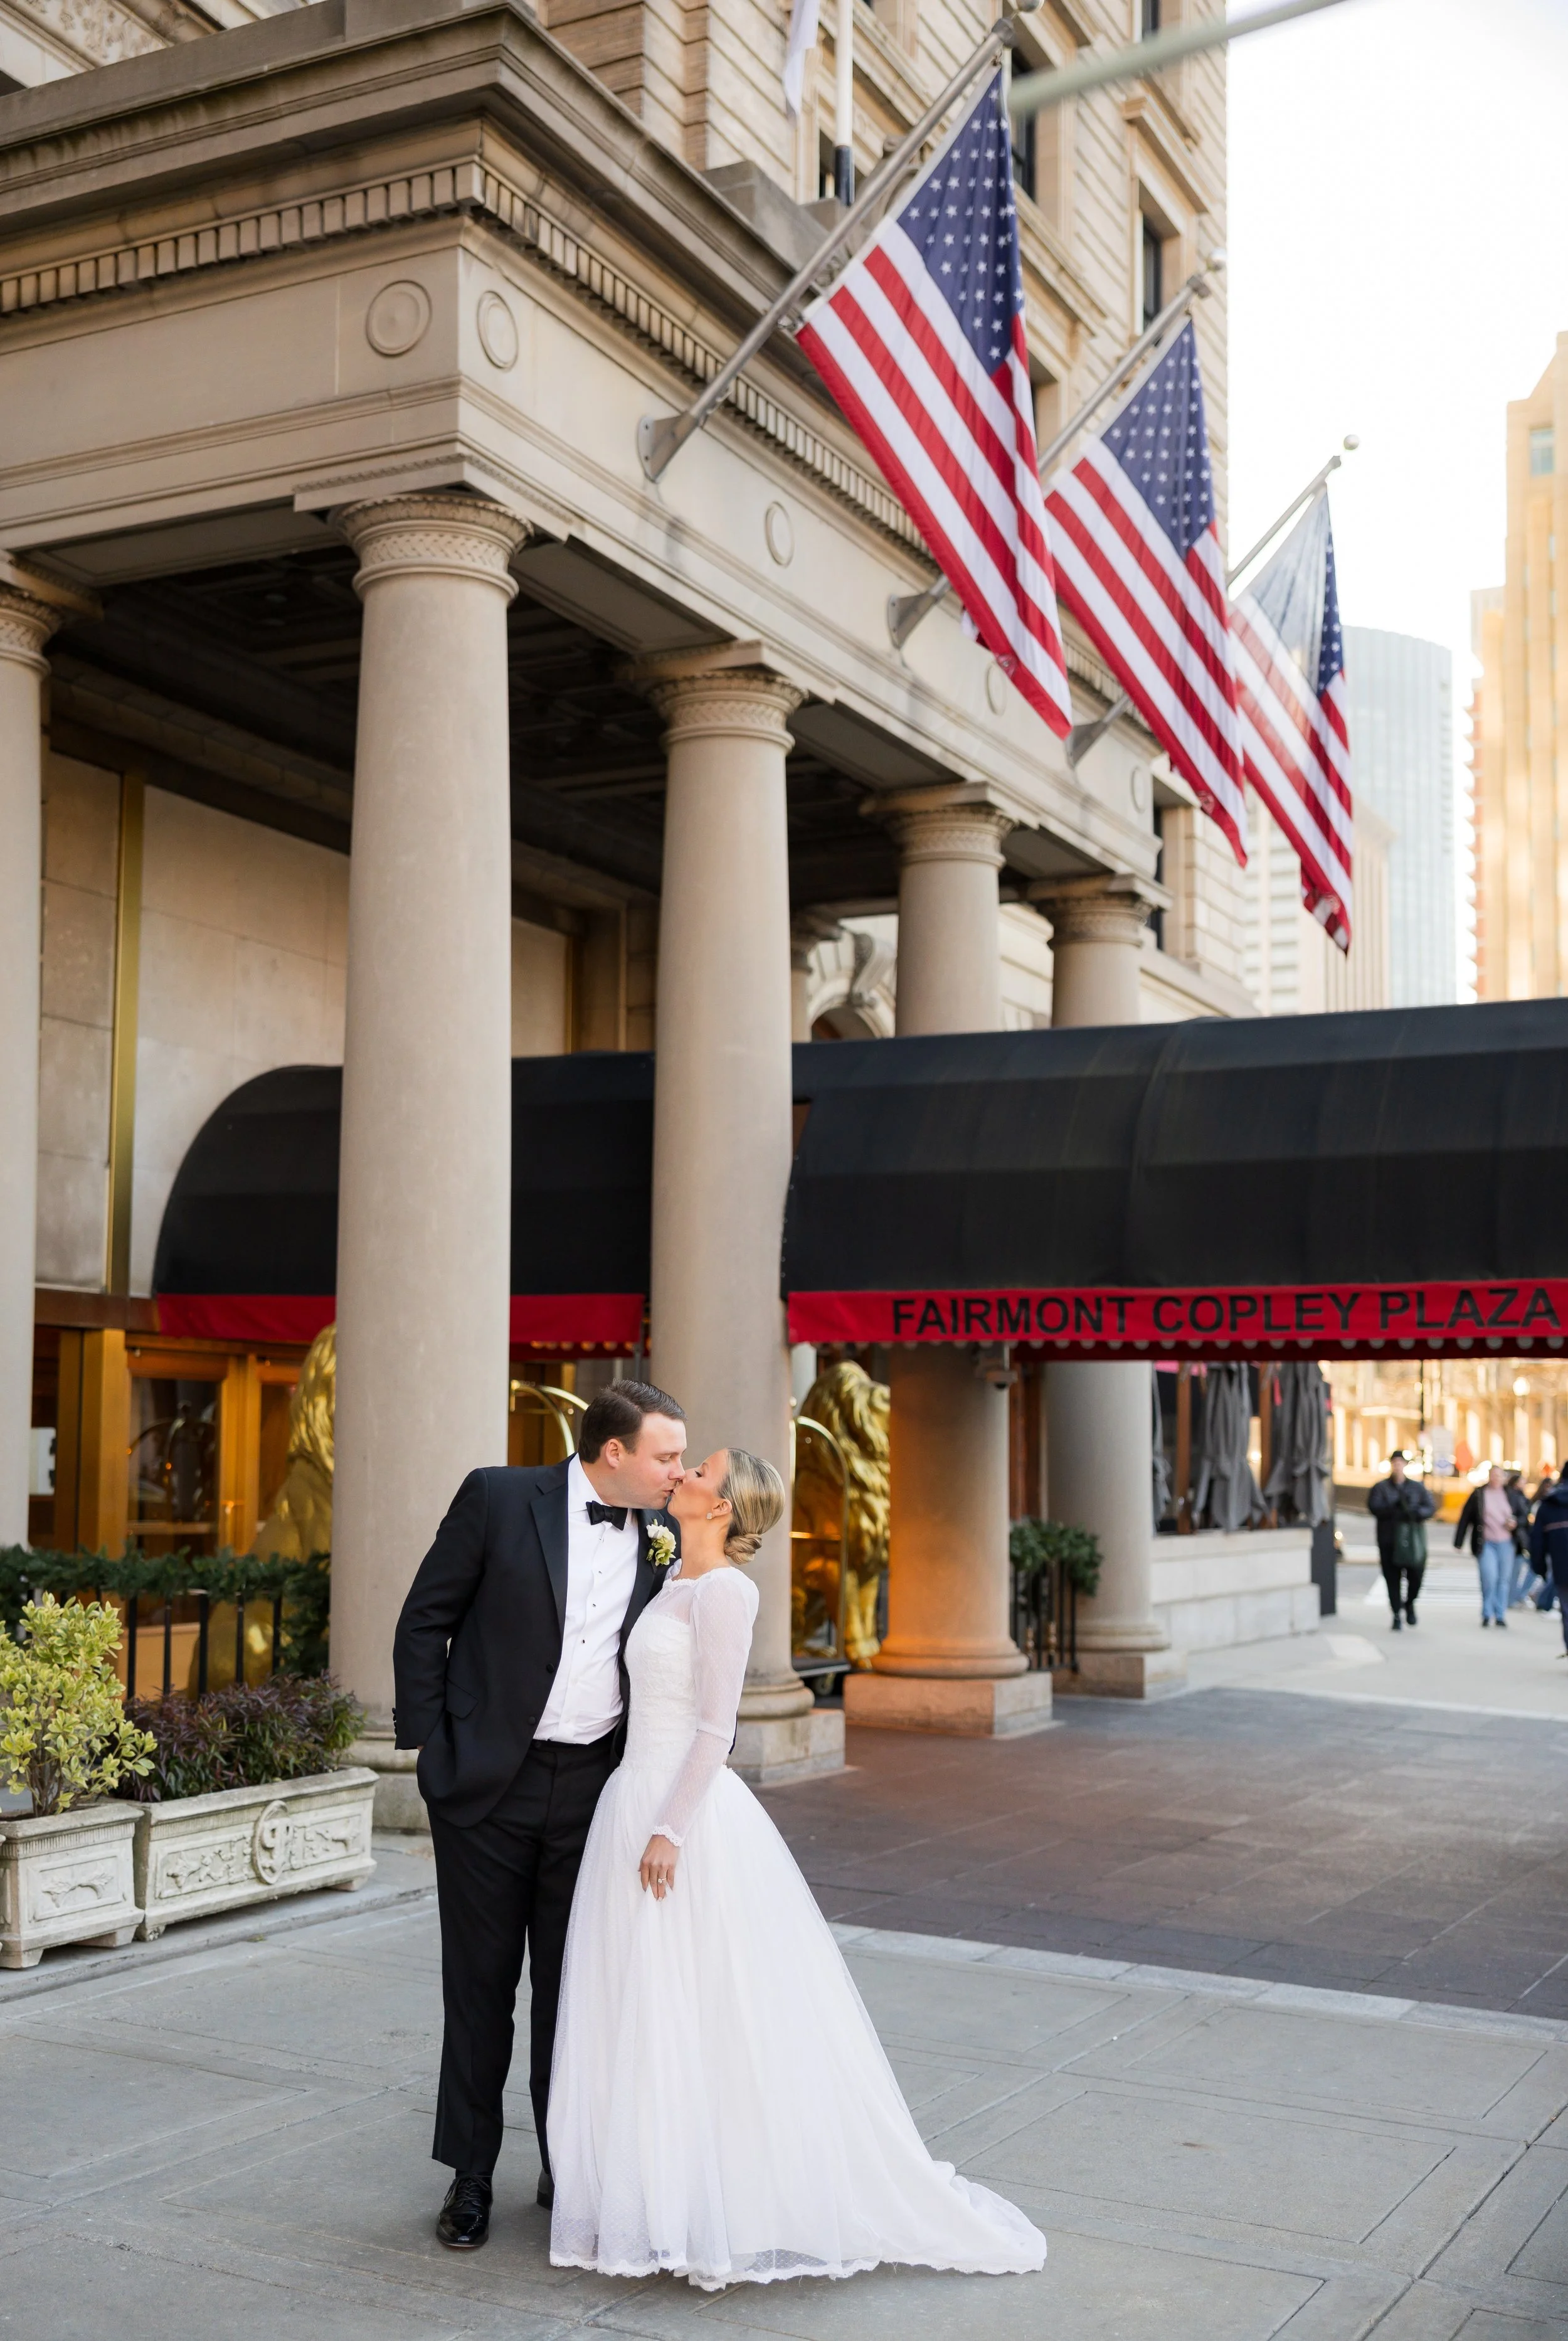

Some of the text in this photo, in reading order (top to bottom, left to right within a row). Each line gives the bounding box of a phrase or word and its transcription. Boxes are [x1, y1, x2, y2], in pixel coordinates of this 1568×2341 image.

[891, 1287, 1562, 1335] FAIRMONT COPLEY PLAZA
